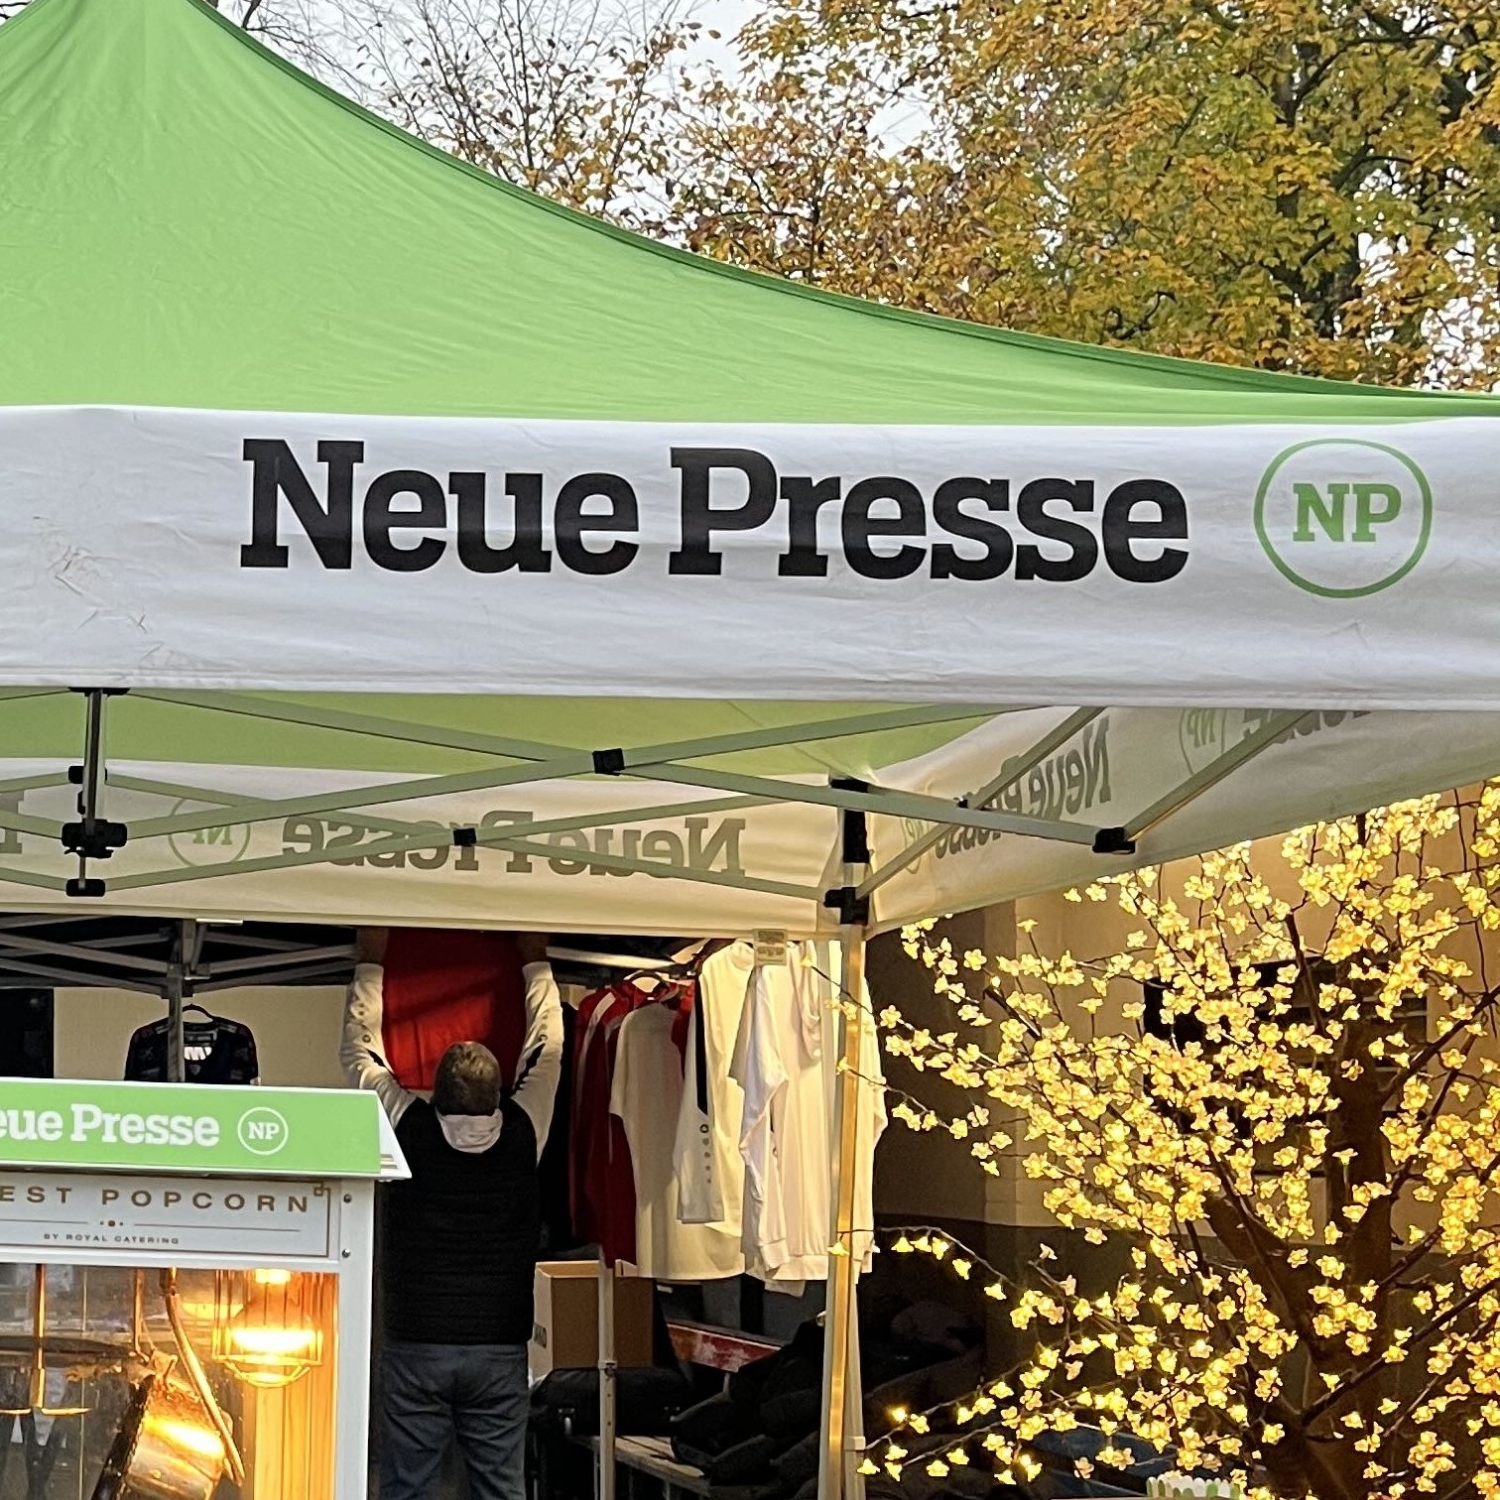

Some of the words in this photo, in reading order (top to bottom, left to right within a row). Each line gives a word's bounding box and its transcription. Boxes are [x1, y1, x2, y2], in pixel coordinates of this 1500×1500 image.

[240, 438, 639, 575] Neue
[668, 446, 1190, 582] Presse
[1291, 482, 1402, 543] NP
[70, 1102, 220, 1148] Presse
[246, 1120, 280, 1140] NP
[102, 1188, 309, 1213] POPCORN
[66, 1234, 107, 1242] ROYAL
[114, 1235, 180, 1245] CATERING
